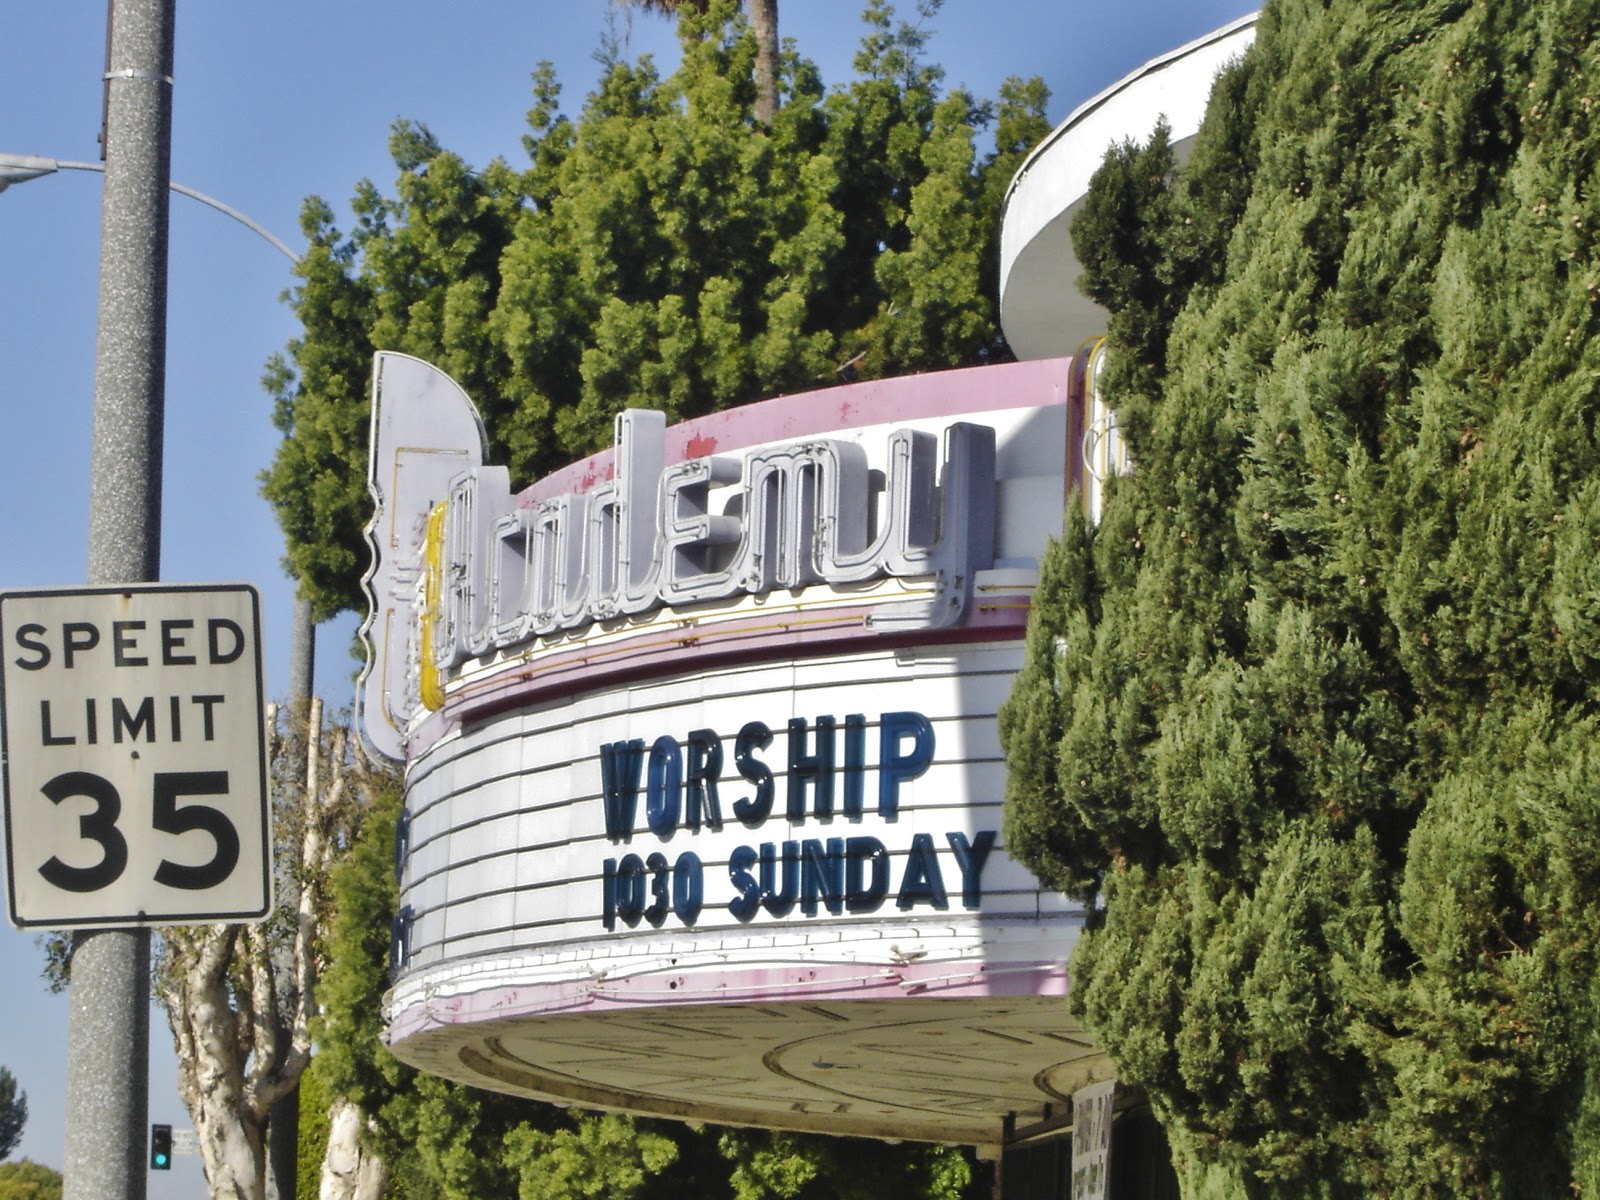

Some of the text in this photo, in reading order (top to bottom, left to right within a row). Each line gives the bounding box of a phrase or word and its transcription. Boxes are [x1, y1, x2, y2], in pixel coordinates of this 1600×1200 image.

[15, 618, 246, 671] SPEED
[40, 694, 225, 746] LIMIT
[599, 711, 936, 844] WORSHIP
[38, 770, 241, 893] 35
[602, 831, 997, 932] 1030 SUNDAY
